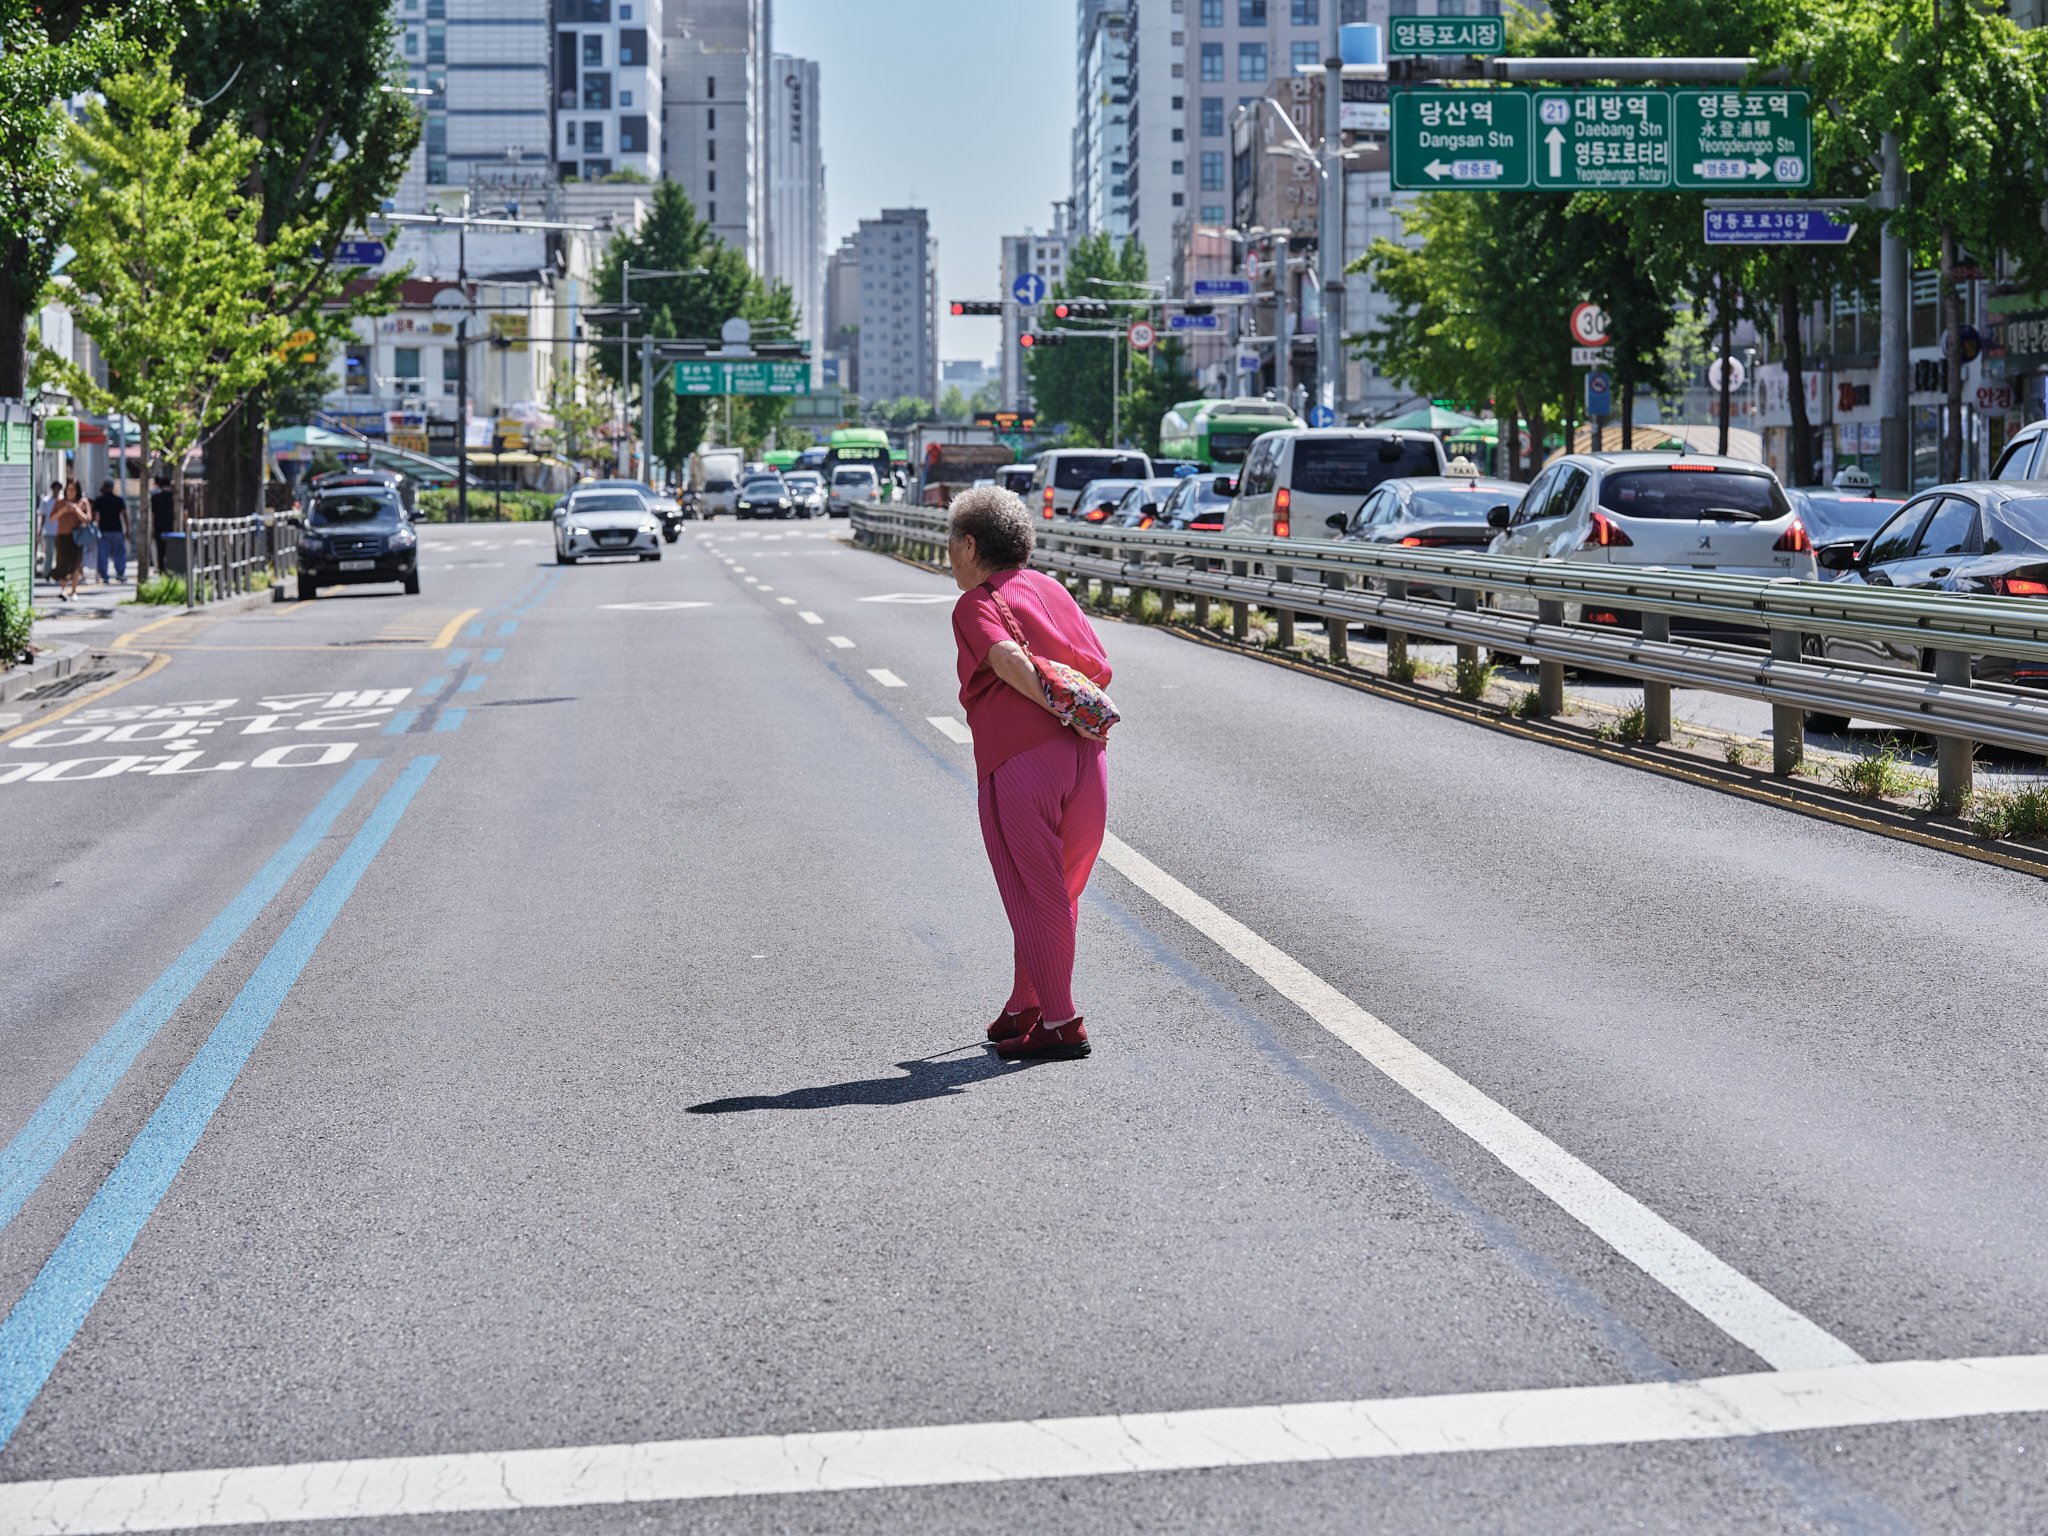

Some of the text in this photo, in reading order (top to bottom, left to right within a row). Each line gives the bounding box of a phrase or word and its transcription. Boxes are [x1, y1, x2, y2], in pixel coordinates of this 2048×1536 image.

[1396, 24, 1497, 46] 영등포시장
[1420, 101, 1493, 126] 당산역
[1546, 103, 1564, 119] 21
[1575, 96, 1647, 121] 대방역
[1698, 95, 1788, 118] 영등포역
[1419, 131, 1514, 151] Dangsan Stn
[1575, 121, 1663, 140] Daebang Stn
[1575, 141, 1668, 165] 영등포로터리
[1698, 137, 1796, 157] Yeongdeungpo Stn
[1780, 161, 1799, 177] 60
[1709, 213, 1809, 230] 영등포로36길
[1583, 312, 1607, 335] 30
[1977, 387, 2011, 409] 안경
[1847, 476, 1869, 484] TAXI
[9, 708, 393, 749] 21:00
